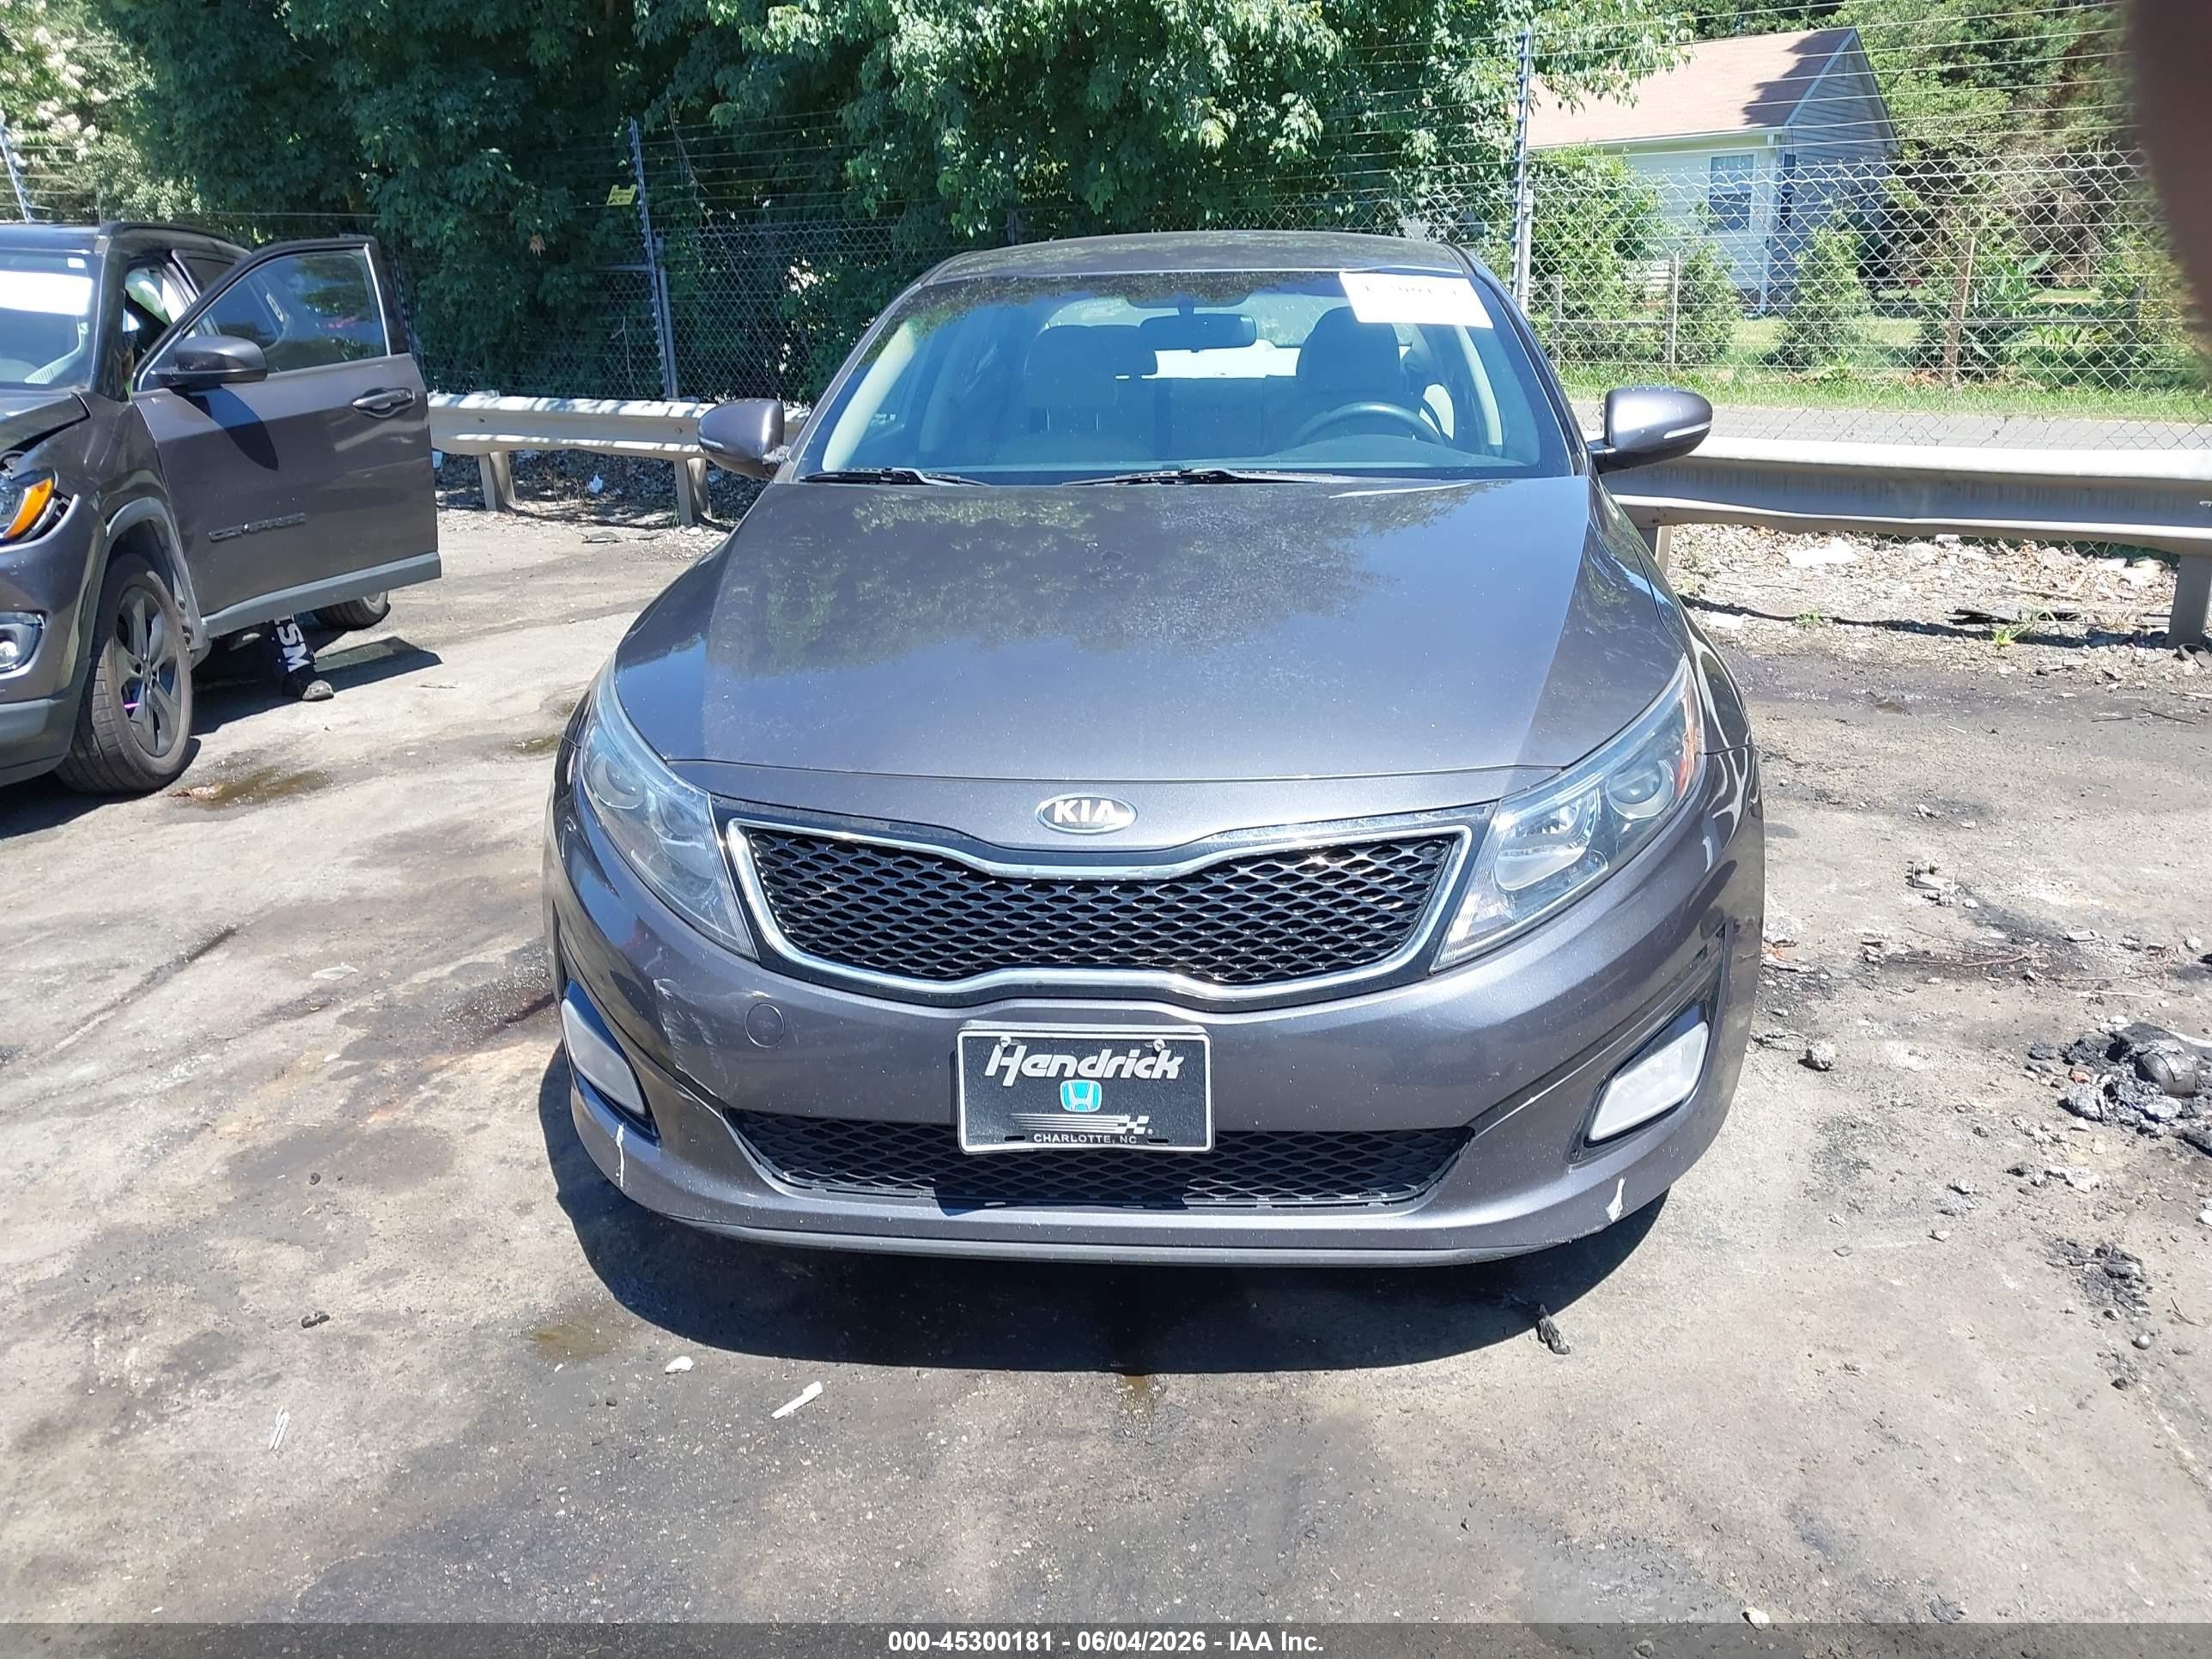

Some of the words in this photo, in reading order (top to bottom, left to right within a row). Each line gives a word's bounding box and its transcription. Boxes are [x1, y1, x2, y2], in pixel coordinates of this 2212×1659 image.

[1054, 799, 1116, 823] KIA
[984, 1045, 1184, 1087] Hendrick
[1033, 1133, 1115, 1146] CHARLOTTE,
[1119, 1135, 1138, 1145] NC
